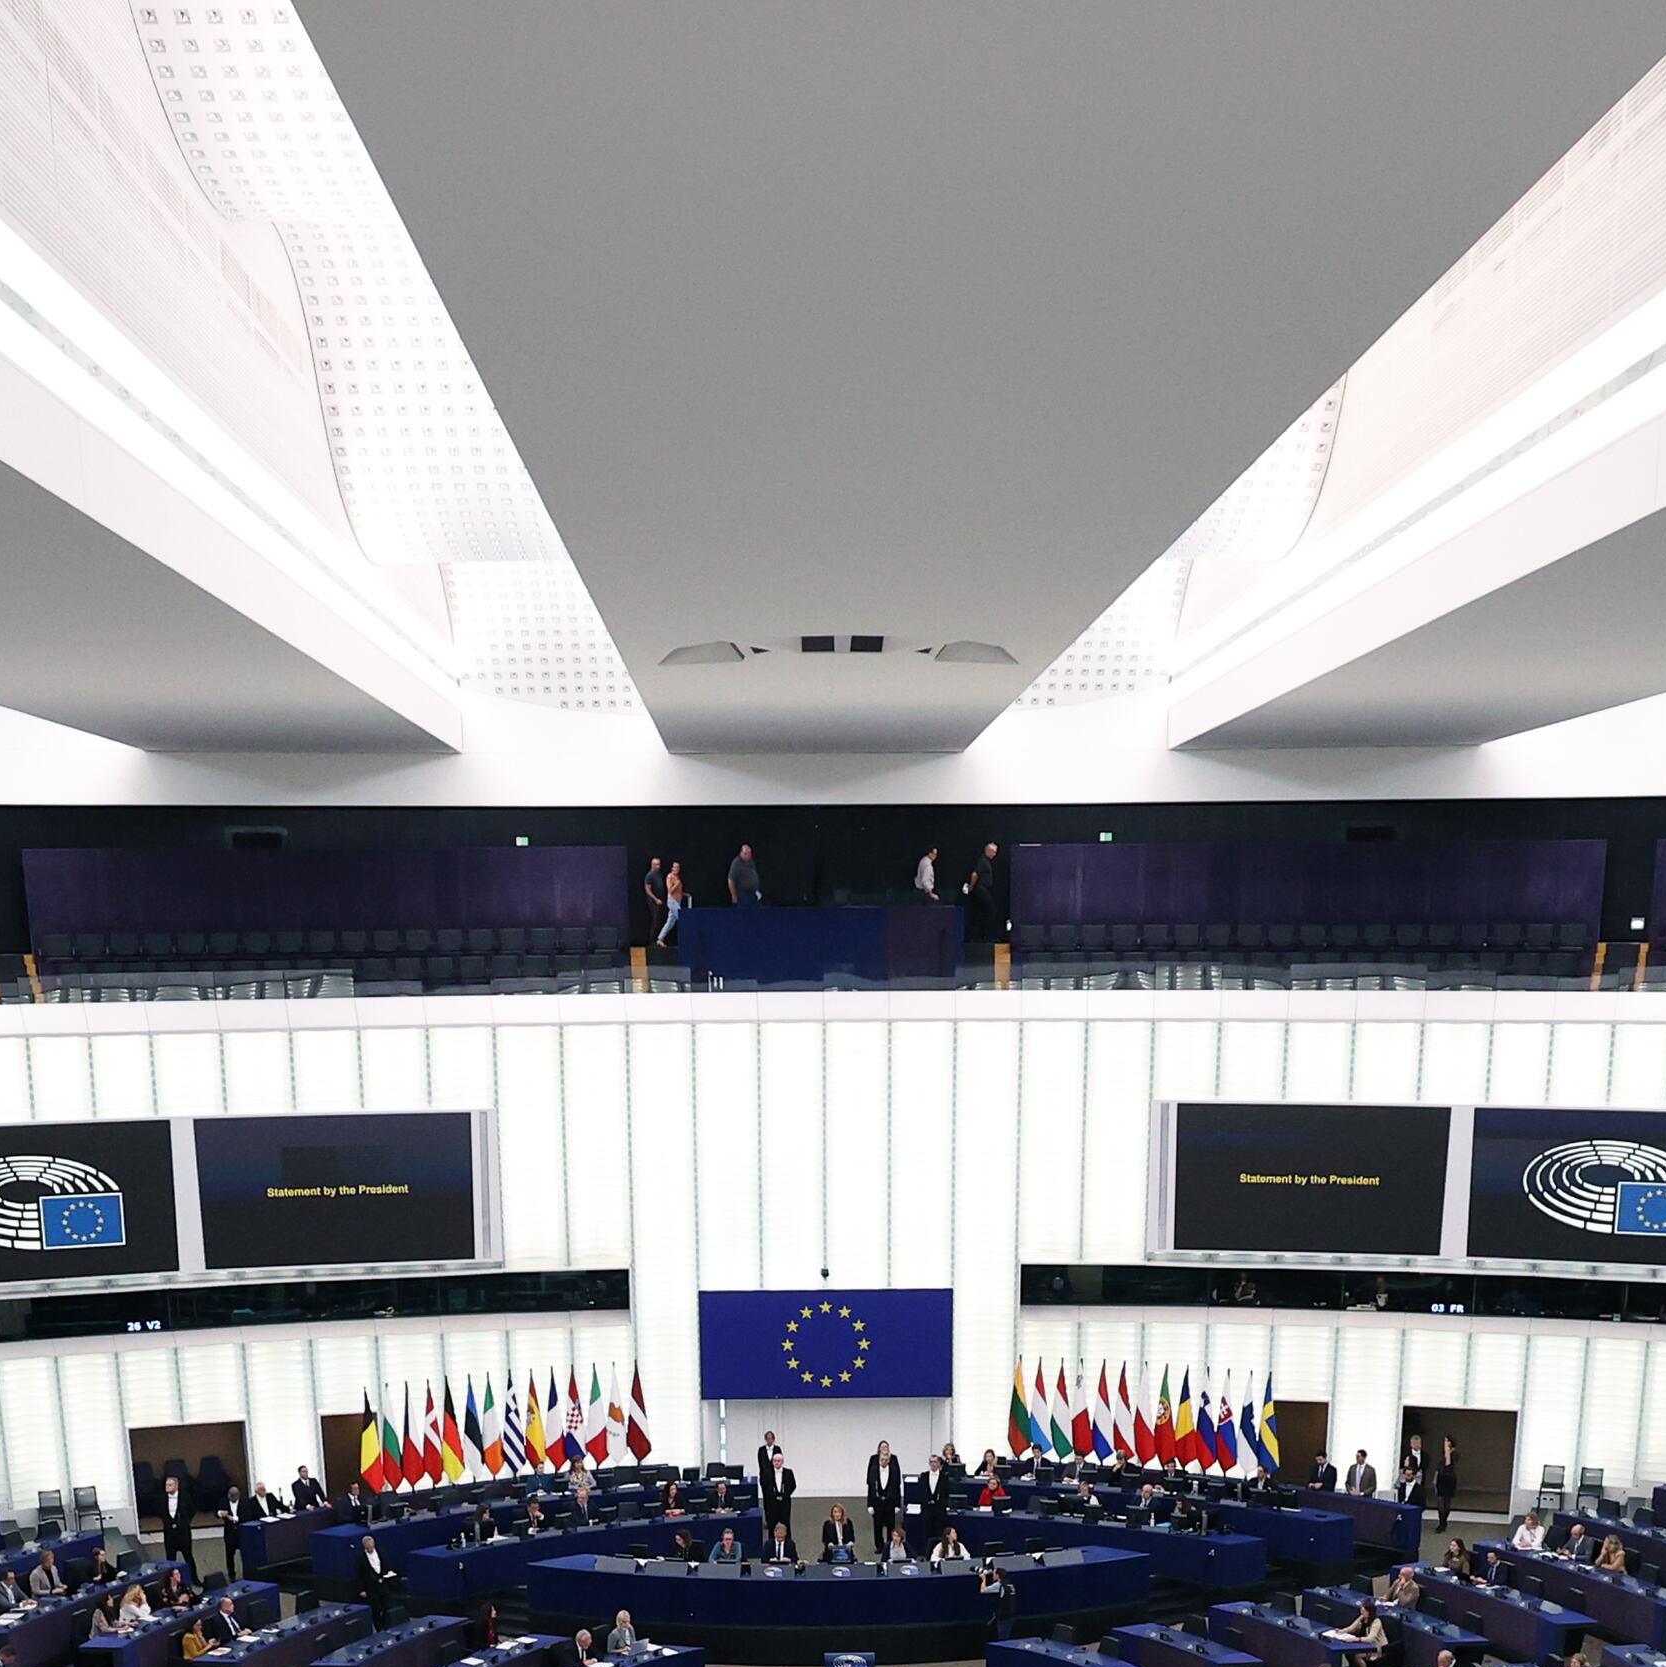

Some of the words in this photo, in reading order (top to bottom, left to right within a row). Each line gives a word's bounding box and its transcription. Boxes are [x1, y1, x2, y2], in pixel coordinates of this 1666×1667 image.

[1239, 1173, 1293, 1184] Statement
[1294, 1174, 1308, 1186] by
[1310, 1175, 1327, 1184] the
[1329, 1174, 1380, 1186] President
[266, 1187, 322, 1198] Statement
[323, 1186, 337, 1198] by
[338, 1186, 357, 1196] the
[358, 1184, 409, 1194] President
[1430, 1303, 1445, 1313] 03
[1449, 1303, 1465, 1314] FR
[126, 1321, 142, 1332] 26
[145, 1320, 162, 1330] V2
